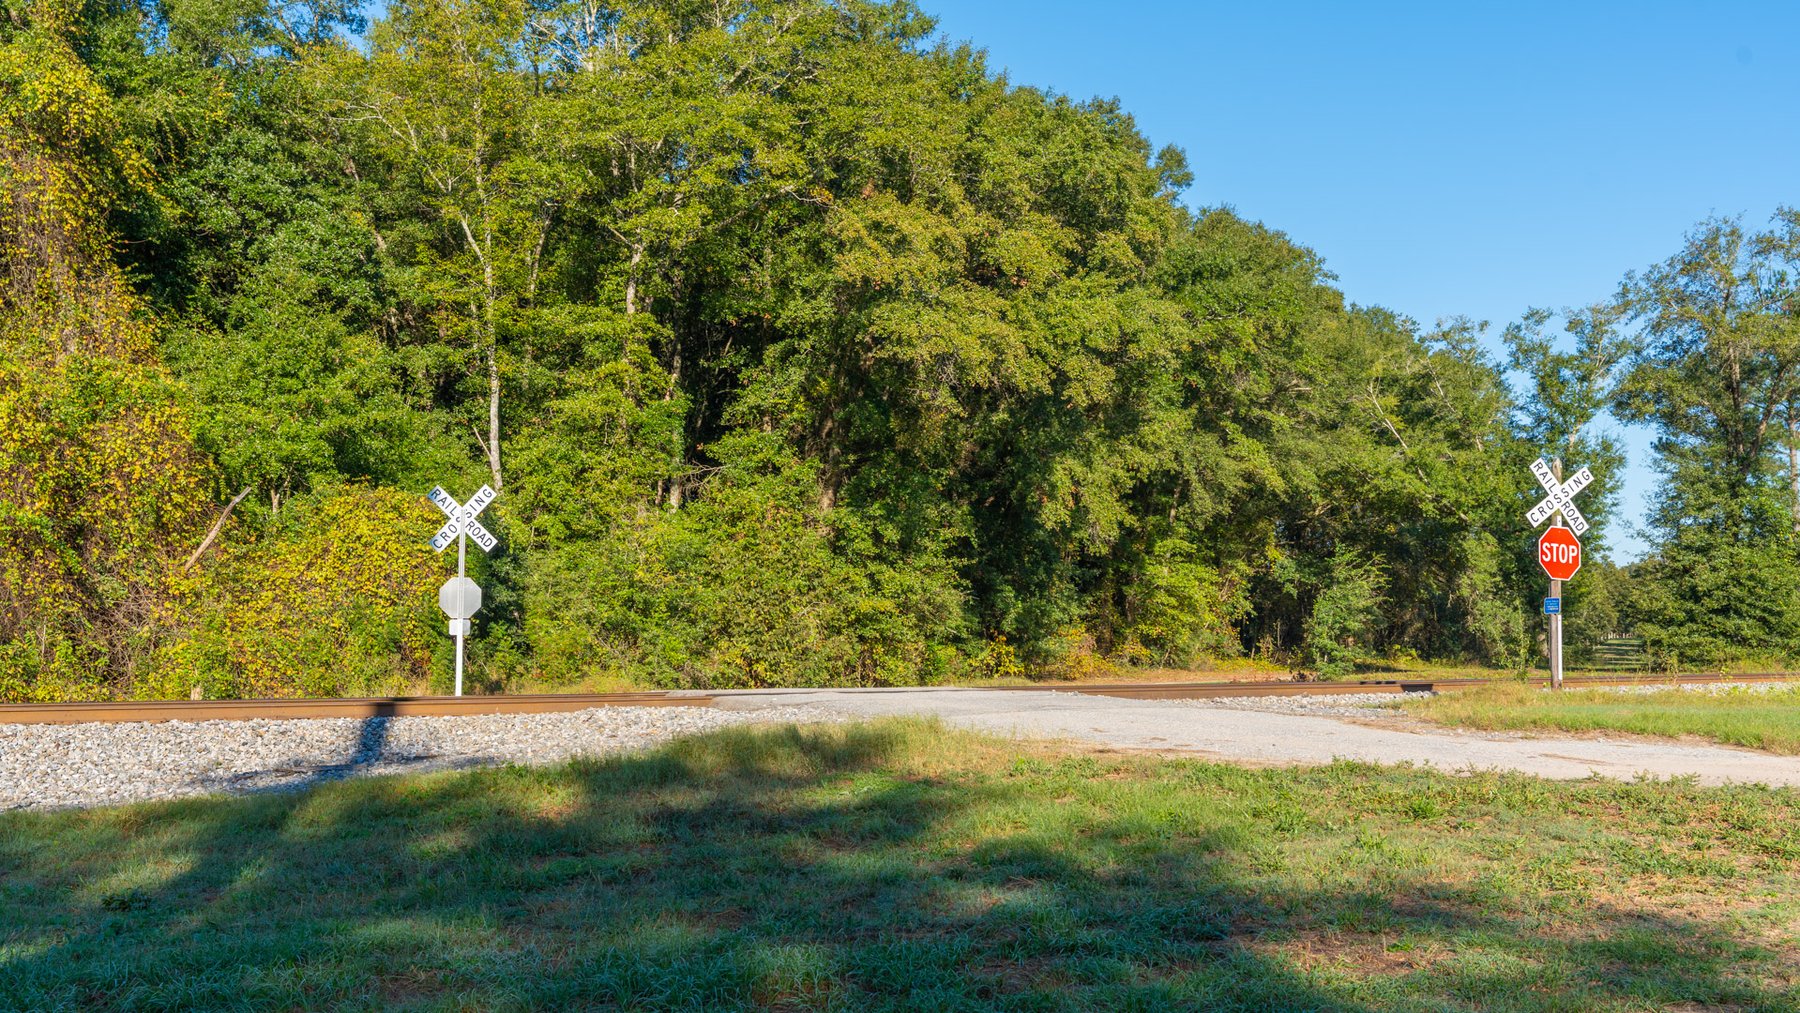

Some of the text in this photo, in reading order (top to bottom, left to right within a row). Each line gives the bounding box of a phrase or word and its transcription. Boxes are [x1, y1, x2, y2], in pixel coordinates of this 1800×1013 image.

[1530, 470, 1590, 523] CROSSING
[1533, 462, 1585, 532] RAILROAD
[1542, 542, 1578, 564] STOP
